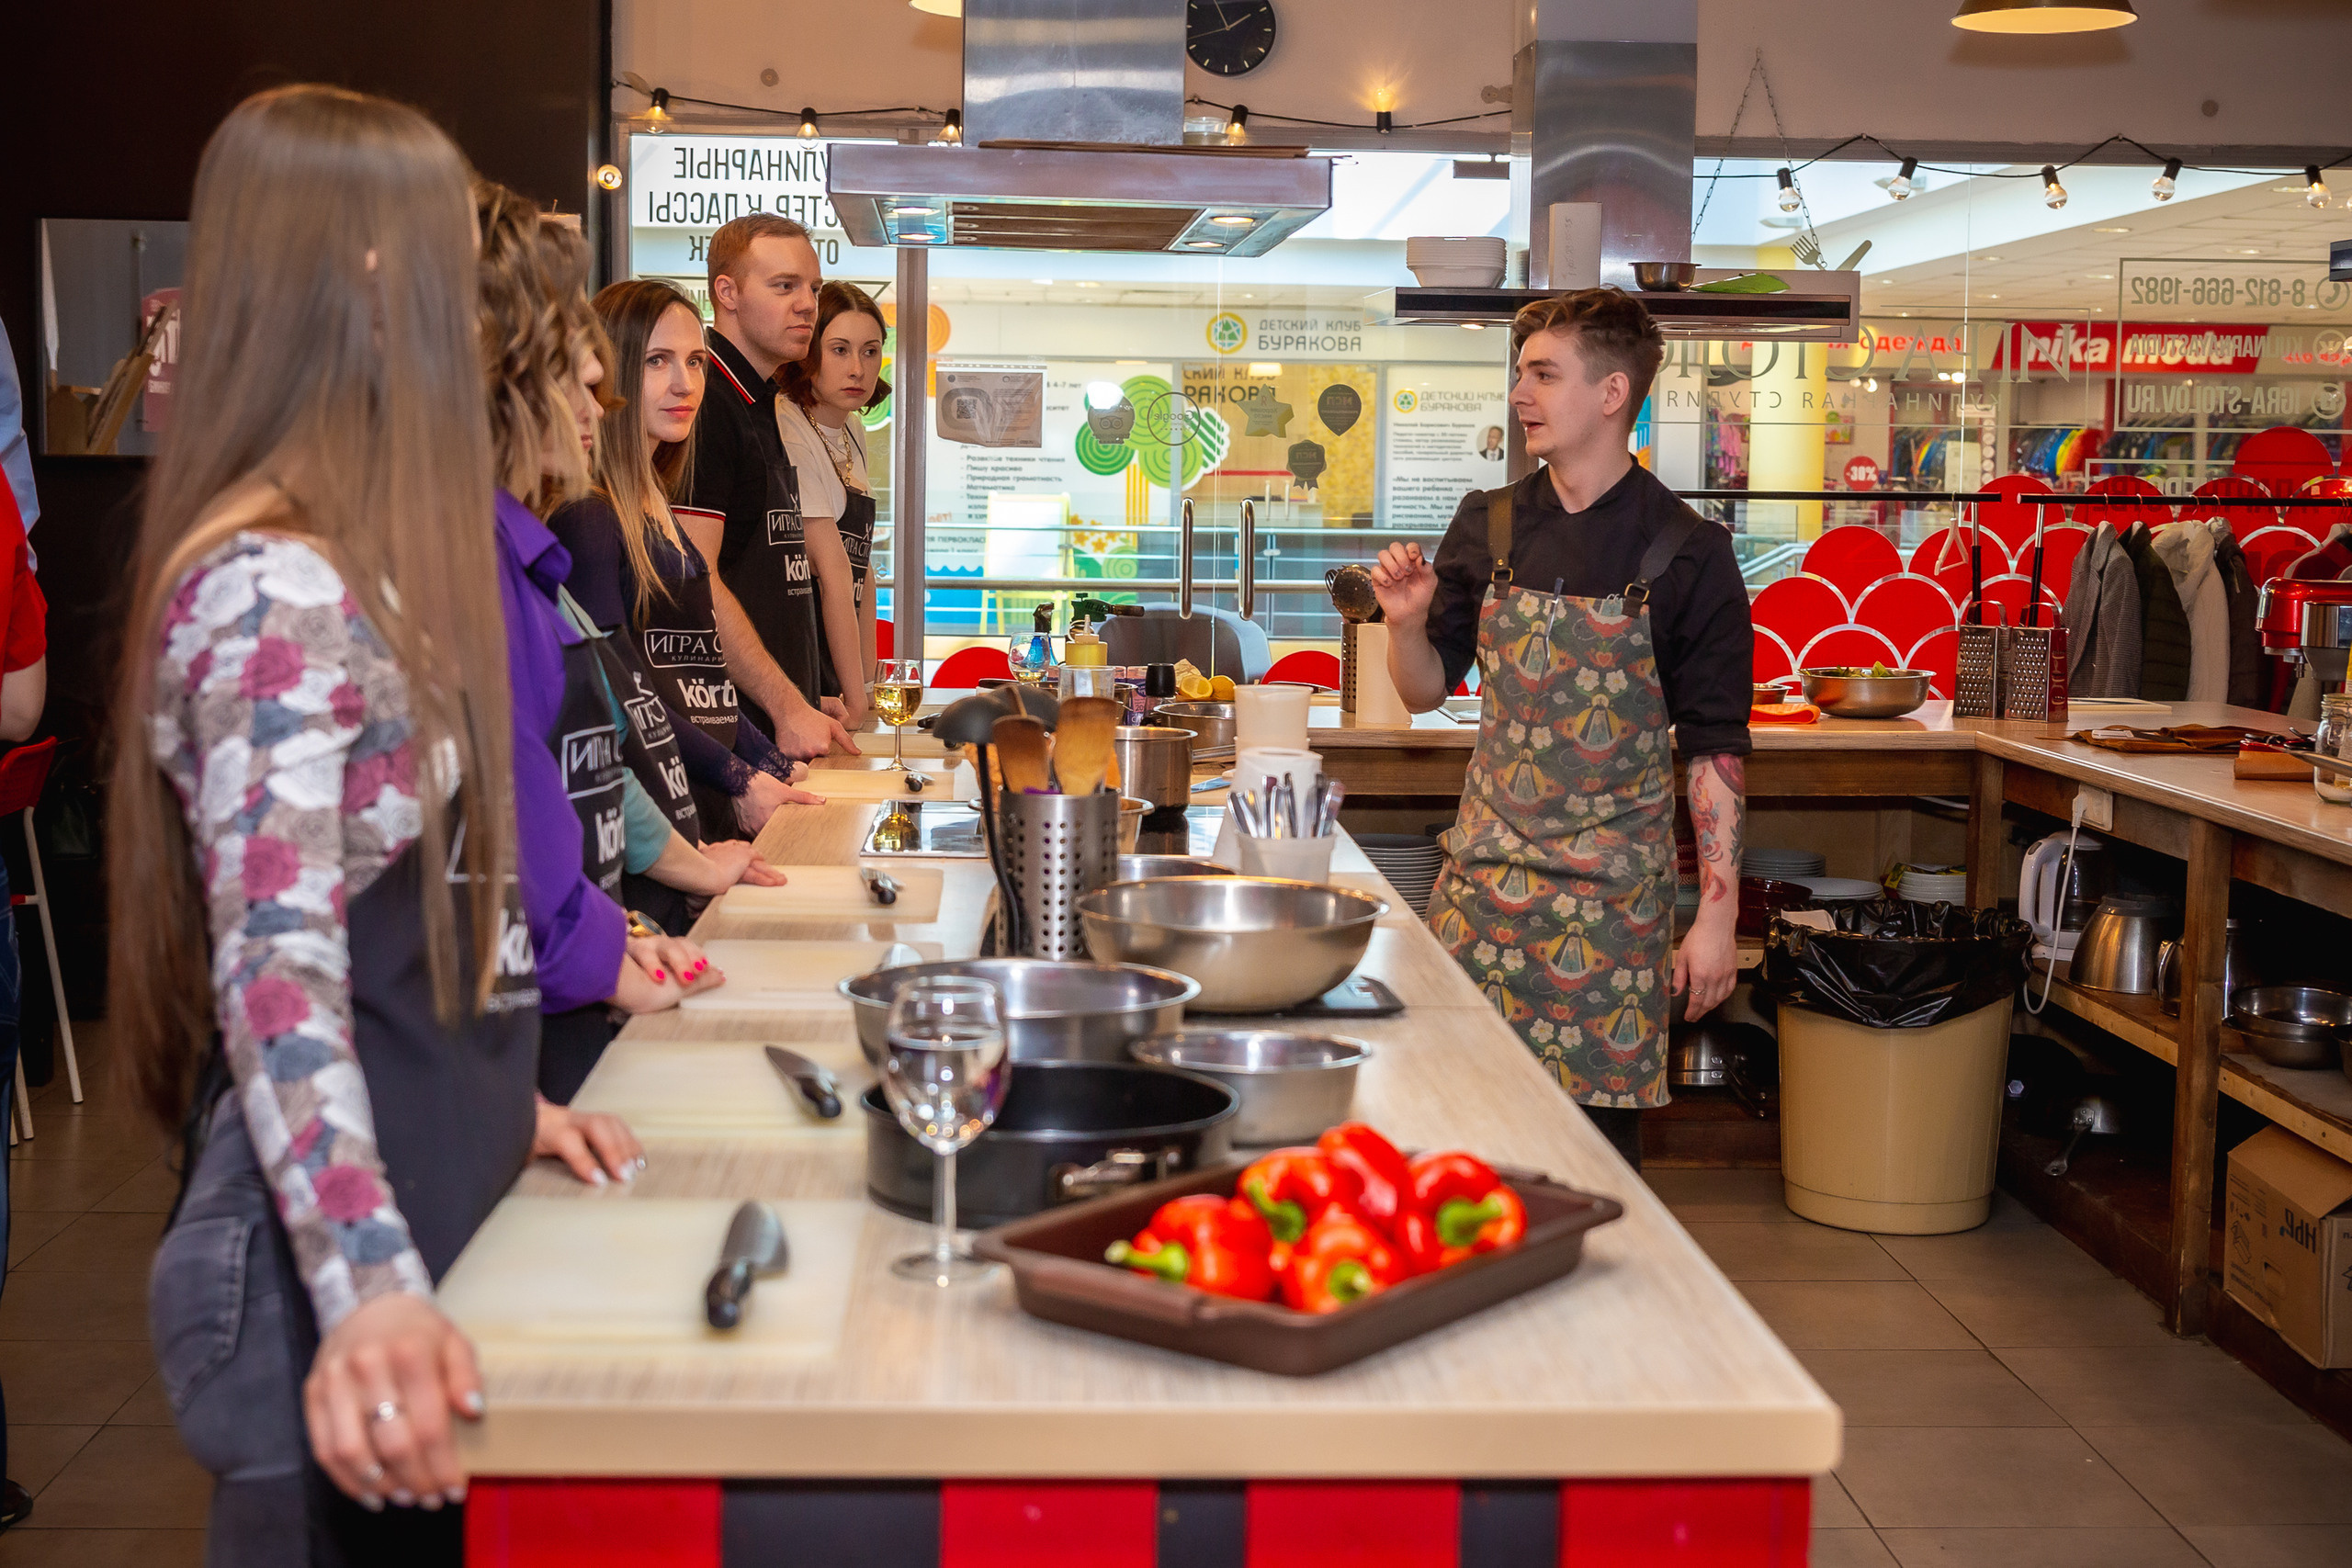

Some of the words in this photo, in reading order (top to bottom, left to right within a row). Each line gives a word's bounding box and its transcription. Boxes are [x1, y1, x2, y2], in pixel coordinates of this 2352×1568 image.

[1259, 319, 1318, 332] ДЕТСКИЙ
[1326, 320, 1362, 332] КЛУБ
[1258, 335, 1362, 352] БУРАКОВА
[650, 634, 708, 654] ИГРА
